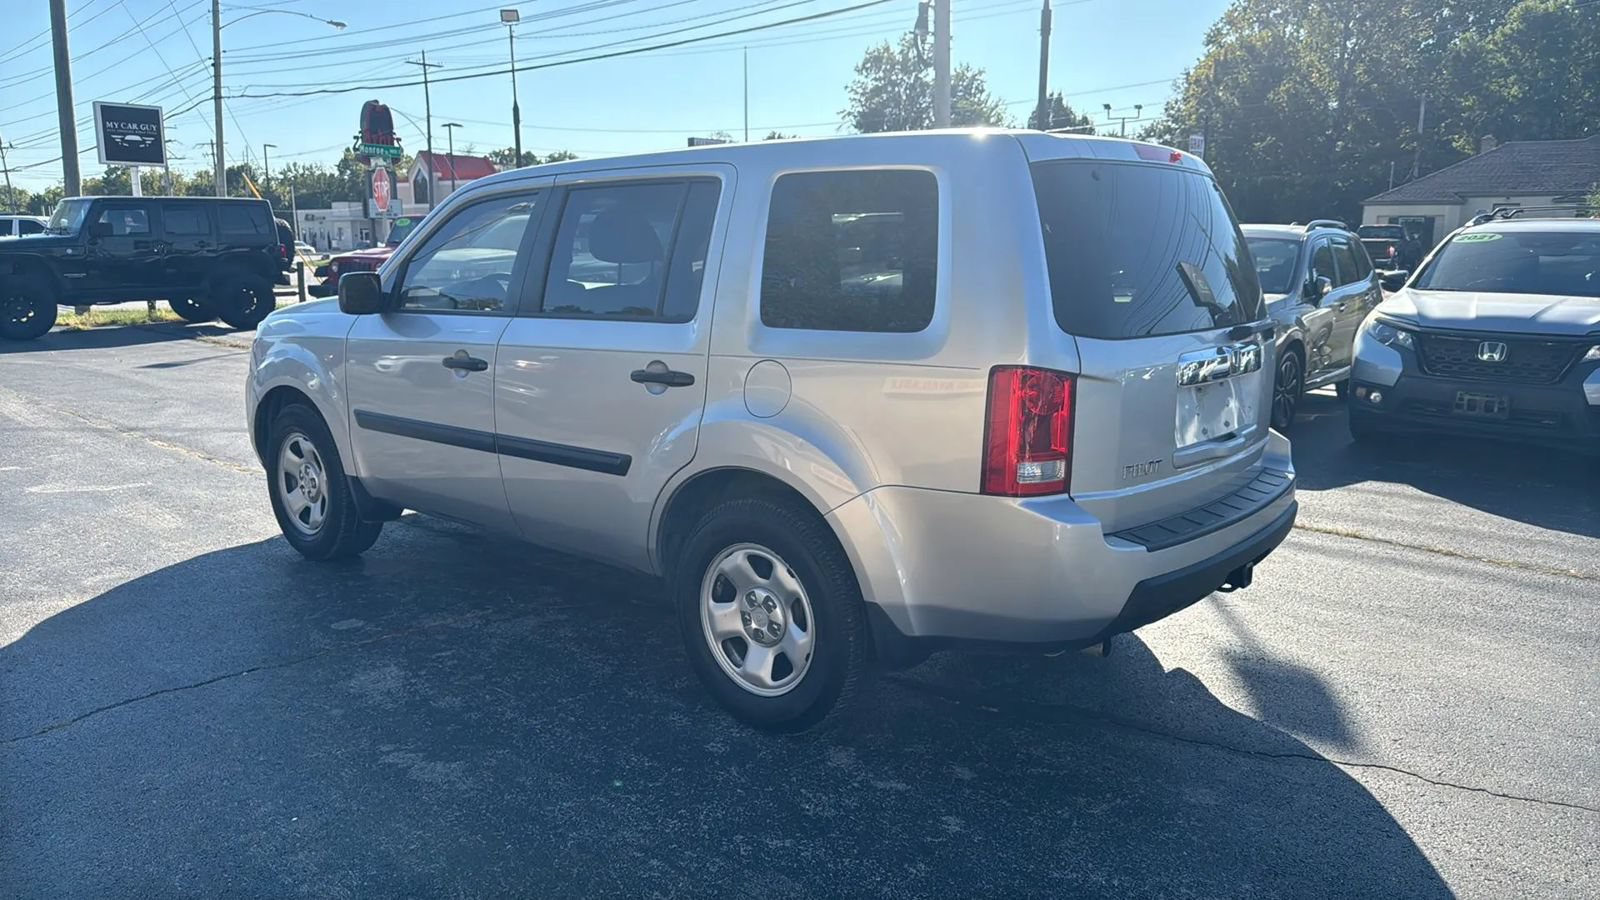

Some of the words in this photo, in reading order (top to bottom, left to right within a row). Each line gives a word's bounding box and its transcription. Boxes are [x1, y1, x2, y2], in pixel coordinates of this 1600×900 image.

[106, 121, 119, 129] MY
[120, 122, 138, 130] CAR
[140, 123, 157, 131] GUY
[359, 144, 385, 155] Monroe
[373, 180, 389, 198] STOP
[1455, 234, 1497, 242] 2021
[1122, 459, 1164, 480] PILOT
